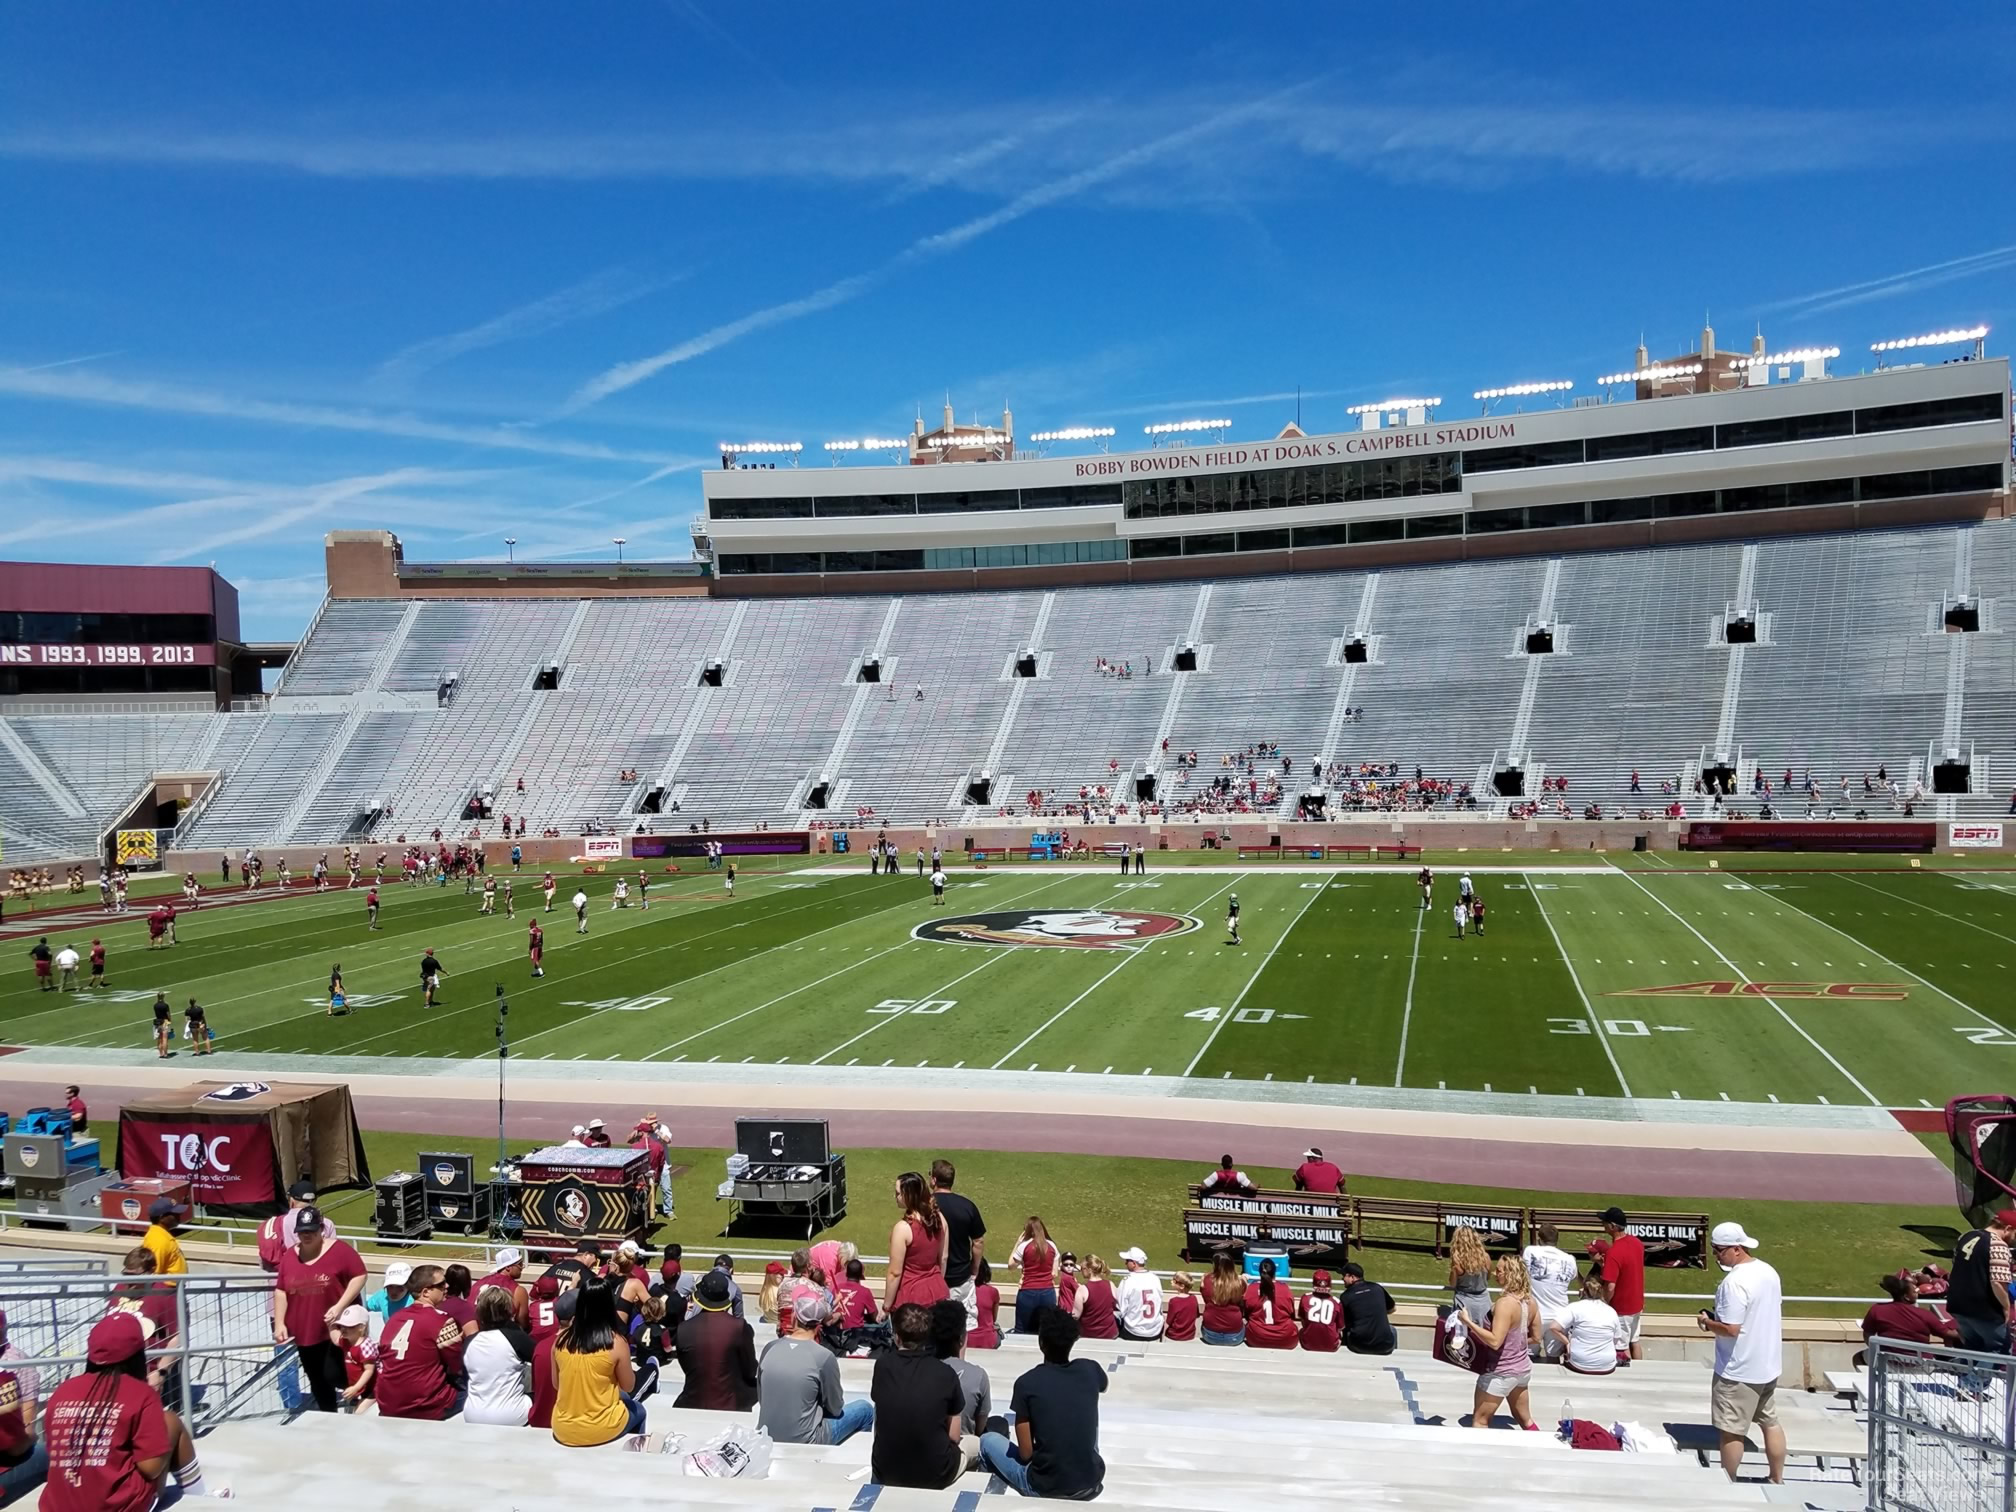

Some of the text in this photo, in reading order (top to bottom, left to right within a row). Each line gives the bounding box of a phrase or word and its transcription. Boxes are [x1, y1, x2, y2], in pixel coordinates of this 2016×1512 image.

[1075, 423, 1515, 477] BOBBY BOWDEN FIELD AT DOAK S. CAMPBELL STADIUM
[41, 646, 92, 665] 1993,
[98, 646, 146, 665] 1999,
[152, 646, 195, 663] 2013
[1953, 828, 1999, 838] ESPN
[588, 841, 619, 850] ESPN
[1600, 981, 1920, 1001] ACC
[865, 999, 959, 1014] 50
[1183, 1006, 1276, 1023] 40
[1546, 1018, 1651, 1036] 30
[221, 1174, 242, 1182] Clinic
[547, 1166, 596, 1174] coachcomm.com
[1202, 1198, 1268, 1214] MUSCLE MILK
[1271, 1203, 1339, 1217] MUSCLE MILK
[1189, 1222, 1258, 1238] MUSCLE MILK
[1446, 1215, 1518, 1232] MUSCLE MILK
[1271, 1227, 1343, 1243] MUSCLE MILK
[1668, 1226, 1697, 1240] MILK
[1961, 1236, 1981, 1261] 4
[1141, 1289, 1155, 1319] 5
[1262, 1300, 1275, 1325] 1
[1307, 1296, 1335, 1325] 20
[539, 1301, 555, 1326] 5
[391, 1319, 415, 1361] 4
[641, 1327, 652, 1347] 4
